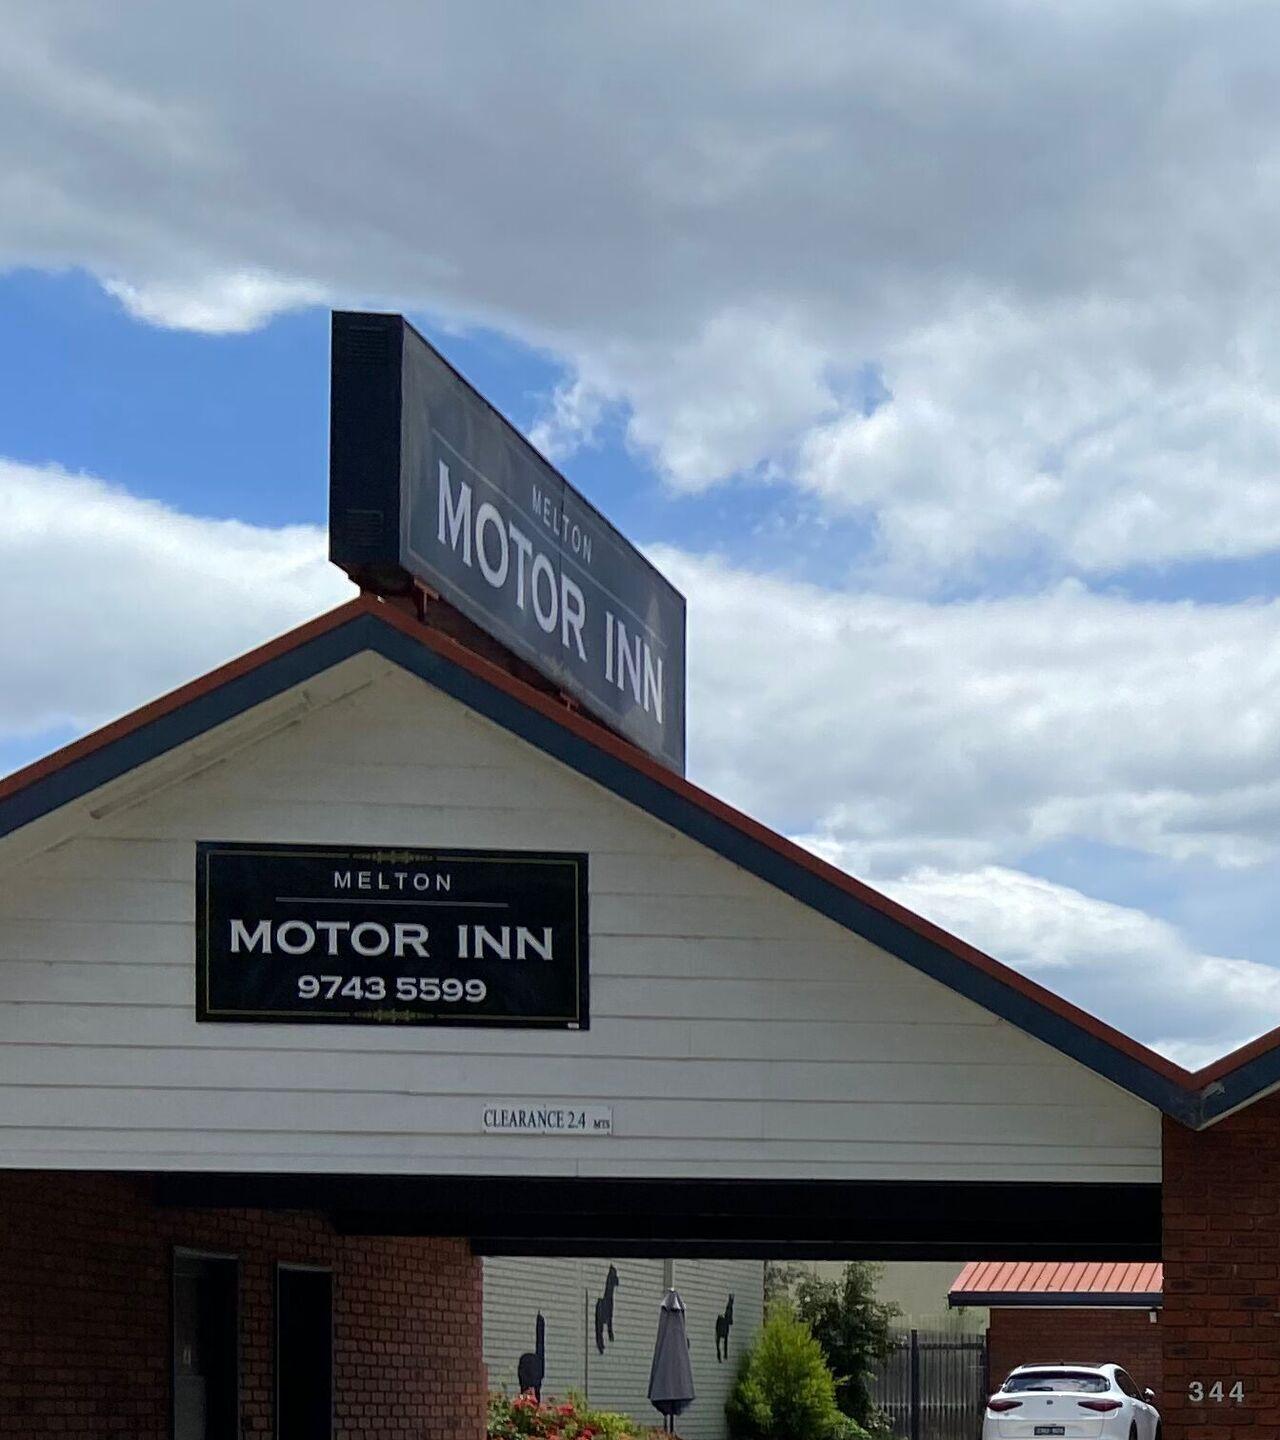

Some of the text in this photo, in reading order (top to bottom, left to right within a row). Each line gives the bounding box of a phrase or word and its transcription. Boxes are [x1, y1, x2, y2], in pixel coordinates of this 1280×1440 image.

[532, 485, 592, 564] MELTON
[437, 459, 663, 724] MOTOR INN
[334, 871, 452, 892] MELTON
[230, 919, 553, 961] MOTOR INN
[298, 975, 487, 1002] 9743 5599
[483, 1109, 564, 1128] CLEARANCE
[1188, 1380, 1245, 1403] 344
